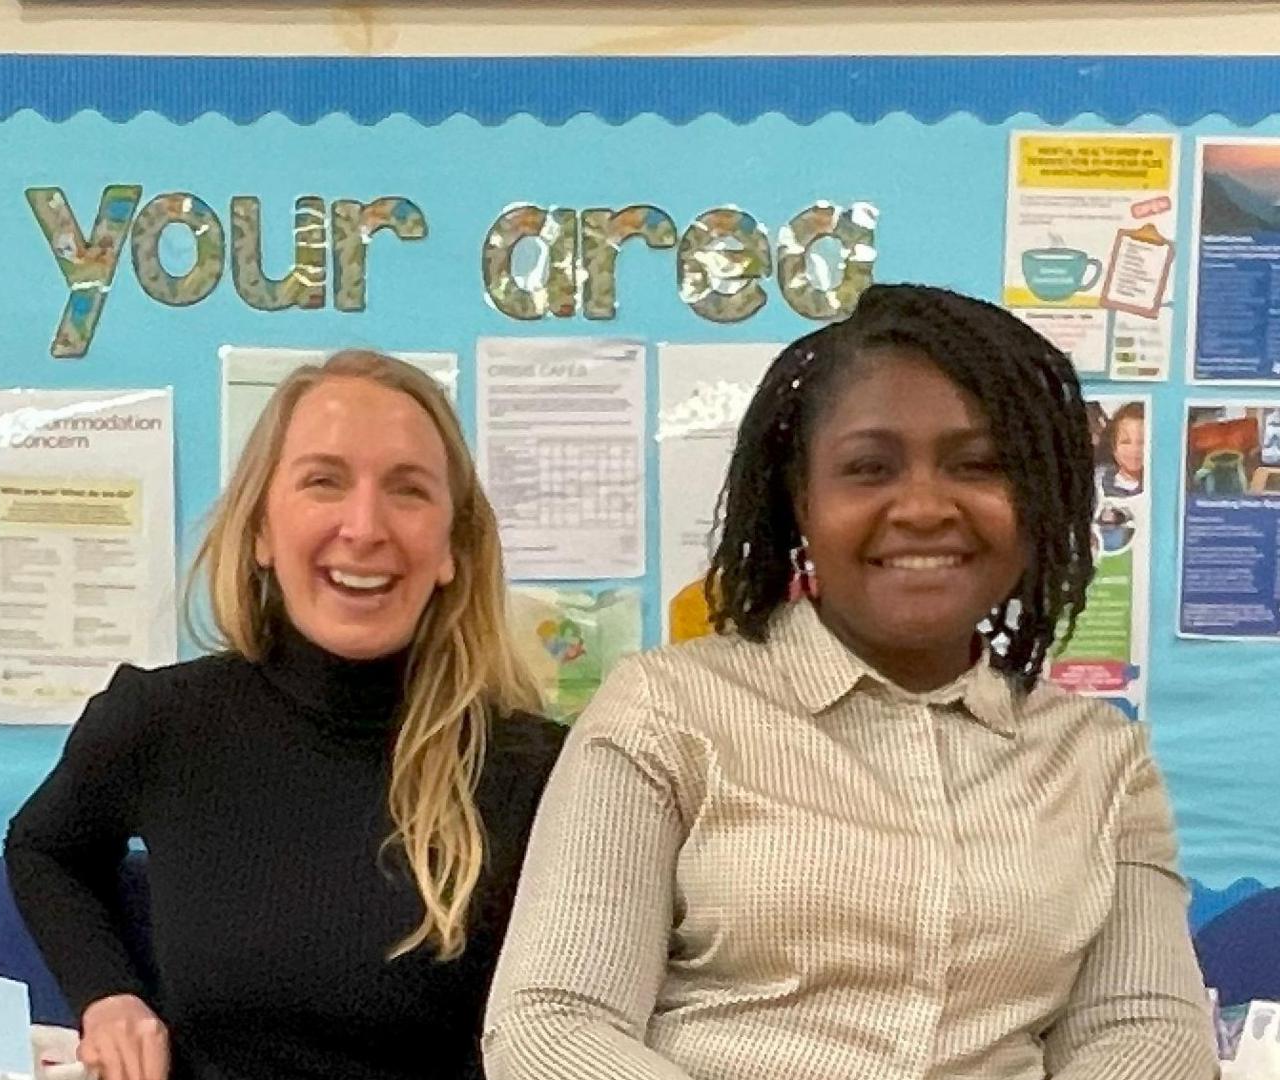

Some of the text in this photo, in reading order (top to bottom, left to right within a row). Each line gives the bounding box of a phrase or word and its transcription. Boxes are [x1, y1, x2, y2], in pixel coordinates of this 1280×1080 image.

[24, 183, 427, 358] your
[481, 200, 878, 322] area
[10, 433, 92, 450] Concern
